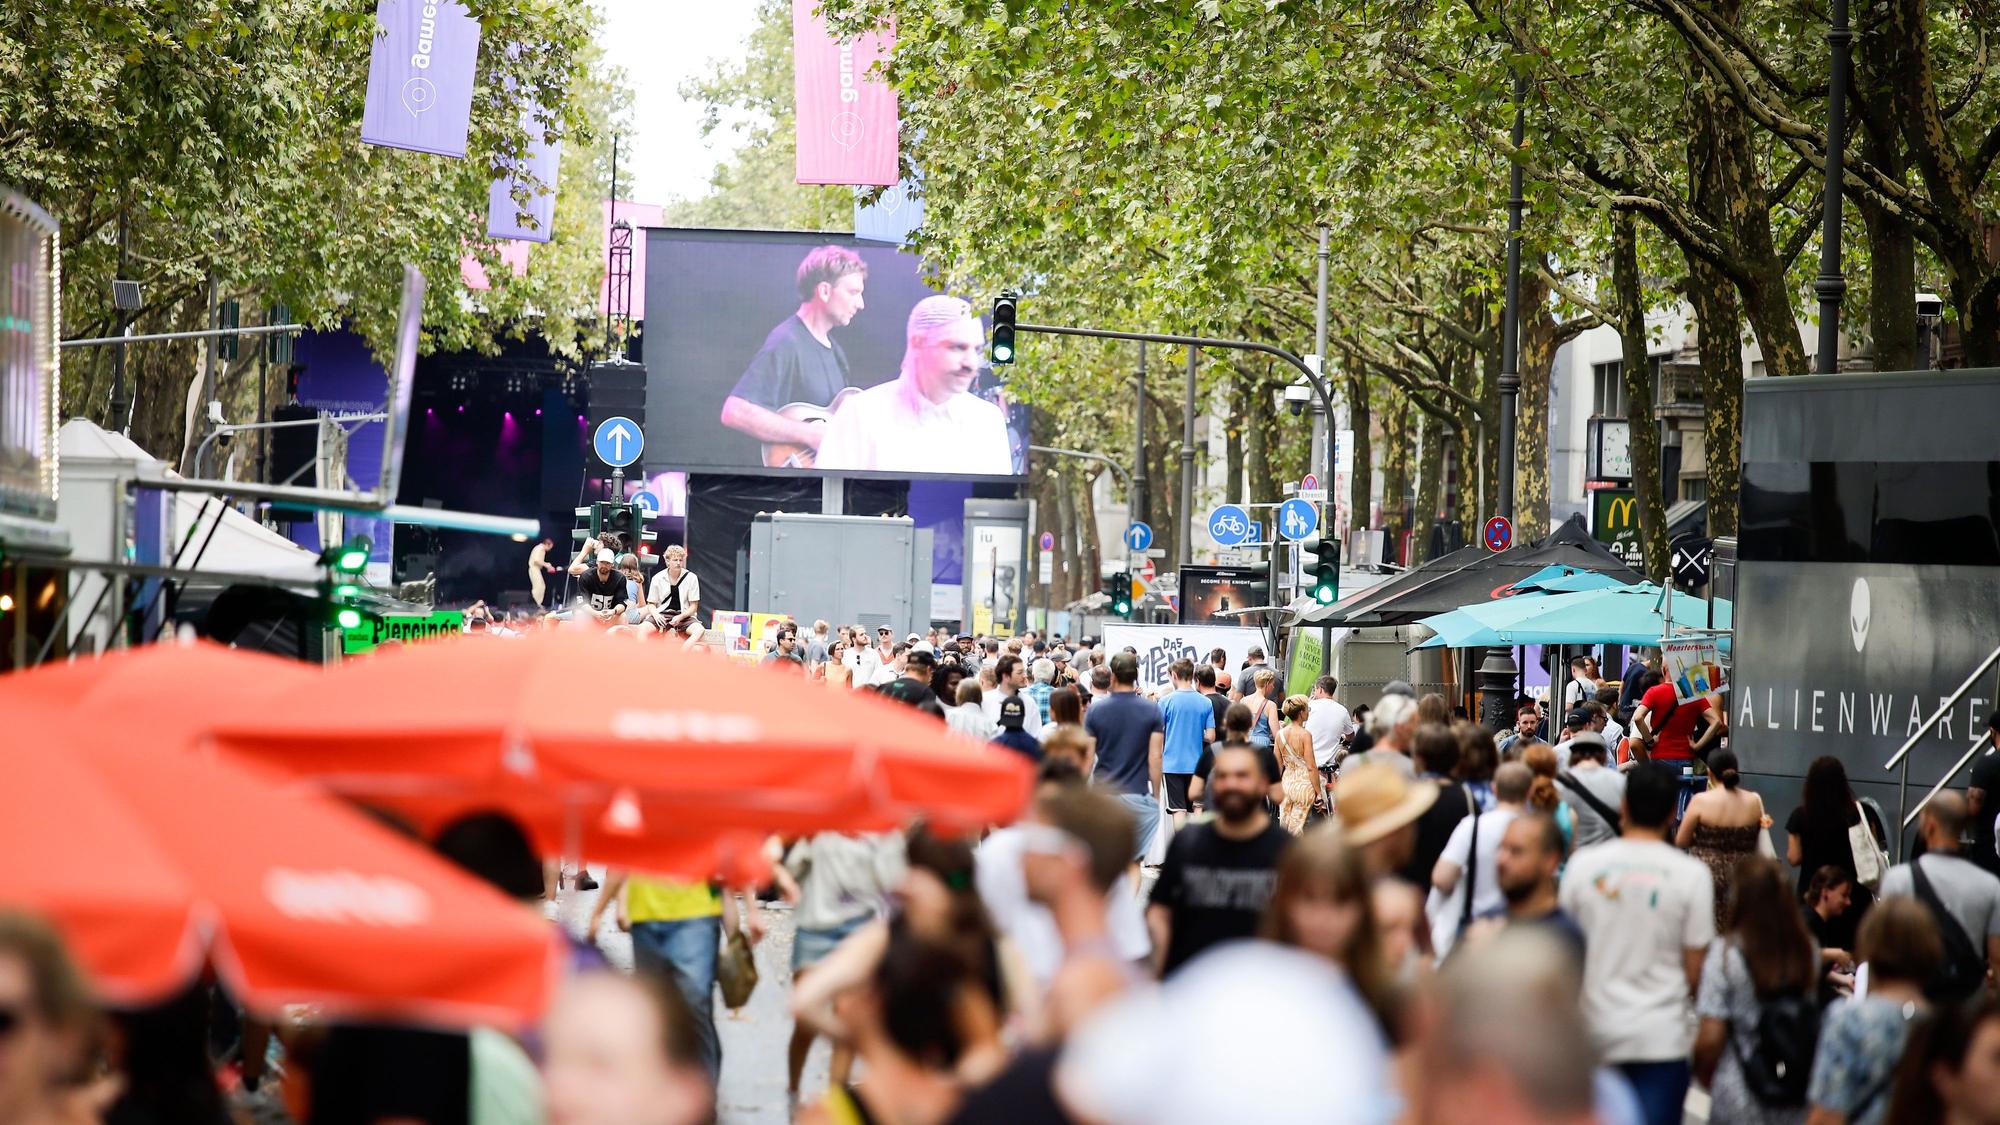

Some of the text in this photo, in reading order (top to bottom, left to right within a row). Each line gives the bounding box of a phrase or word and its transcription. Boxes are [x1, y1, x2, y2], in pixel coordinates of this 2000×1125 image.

[1630, 541, 1638, 552] 2
[1625, 552, 1643, 561] MIN
[1163, 637, 1182, 651] DAS
[1739, 686, 1984, 742] ALIENWARE
